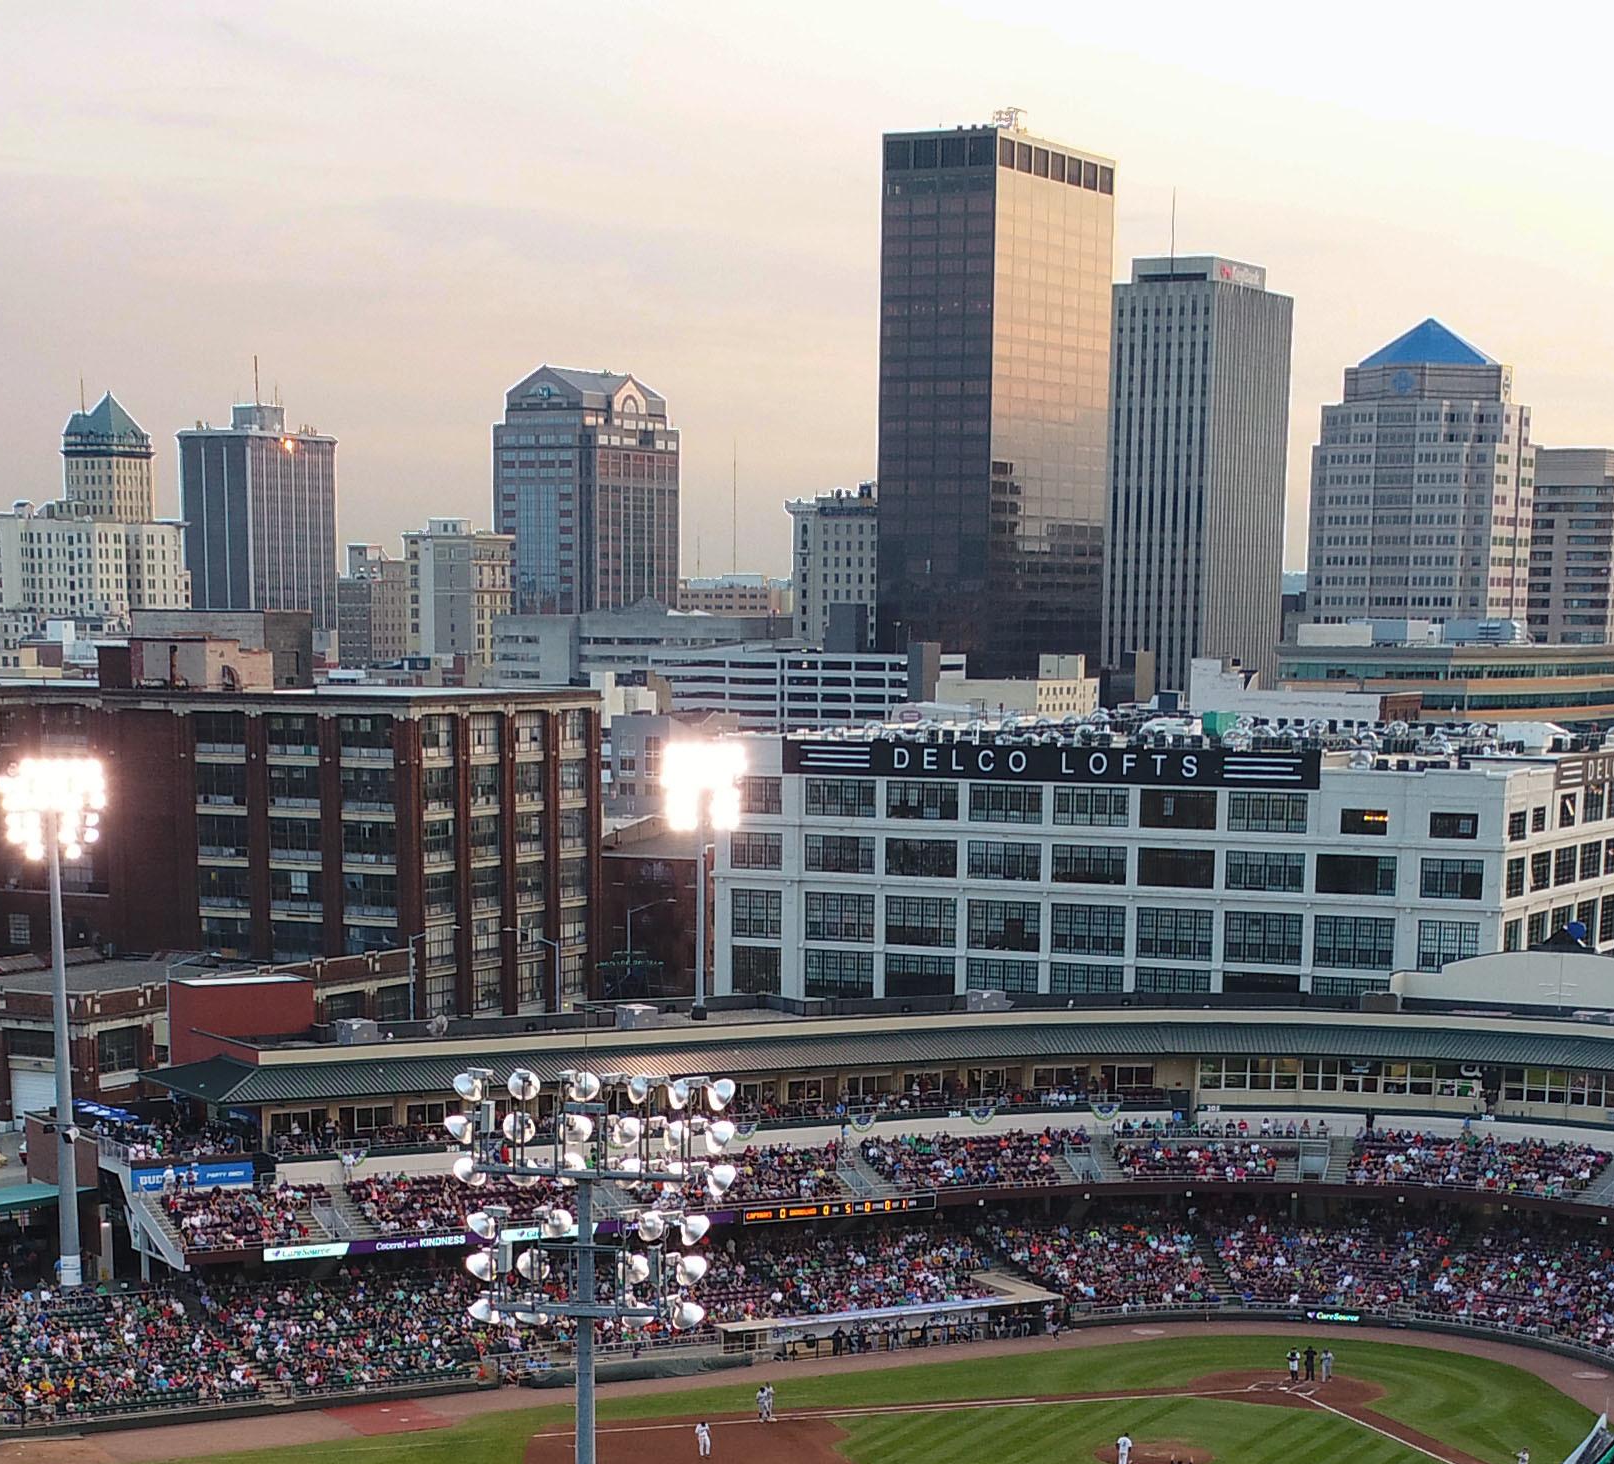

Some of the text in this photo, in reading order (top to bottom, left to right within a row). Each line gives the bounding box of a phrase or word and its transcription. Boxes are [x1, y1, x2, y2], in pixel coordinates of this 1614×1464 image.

[893, 747, 1198, 778] DELCO LOFTS
[376, 1240, 406, 1251] Covered
[419, 1235, 465, 1248] KINDNESS
[1316, 1312, 1359, 1321] CareSource
